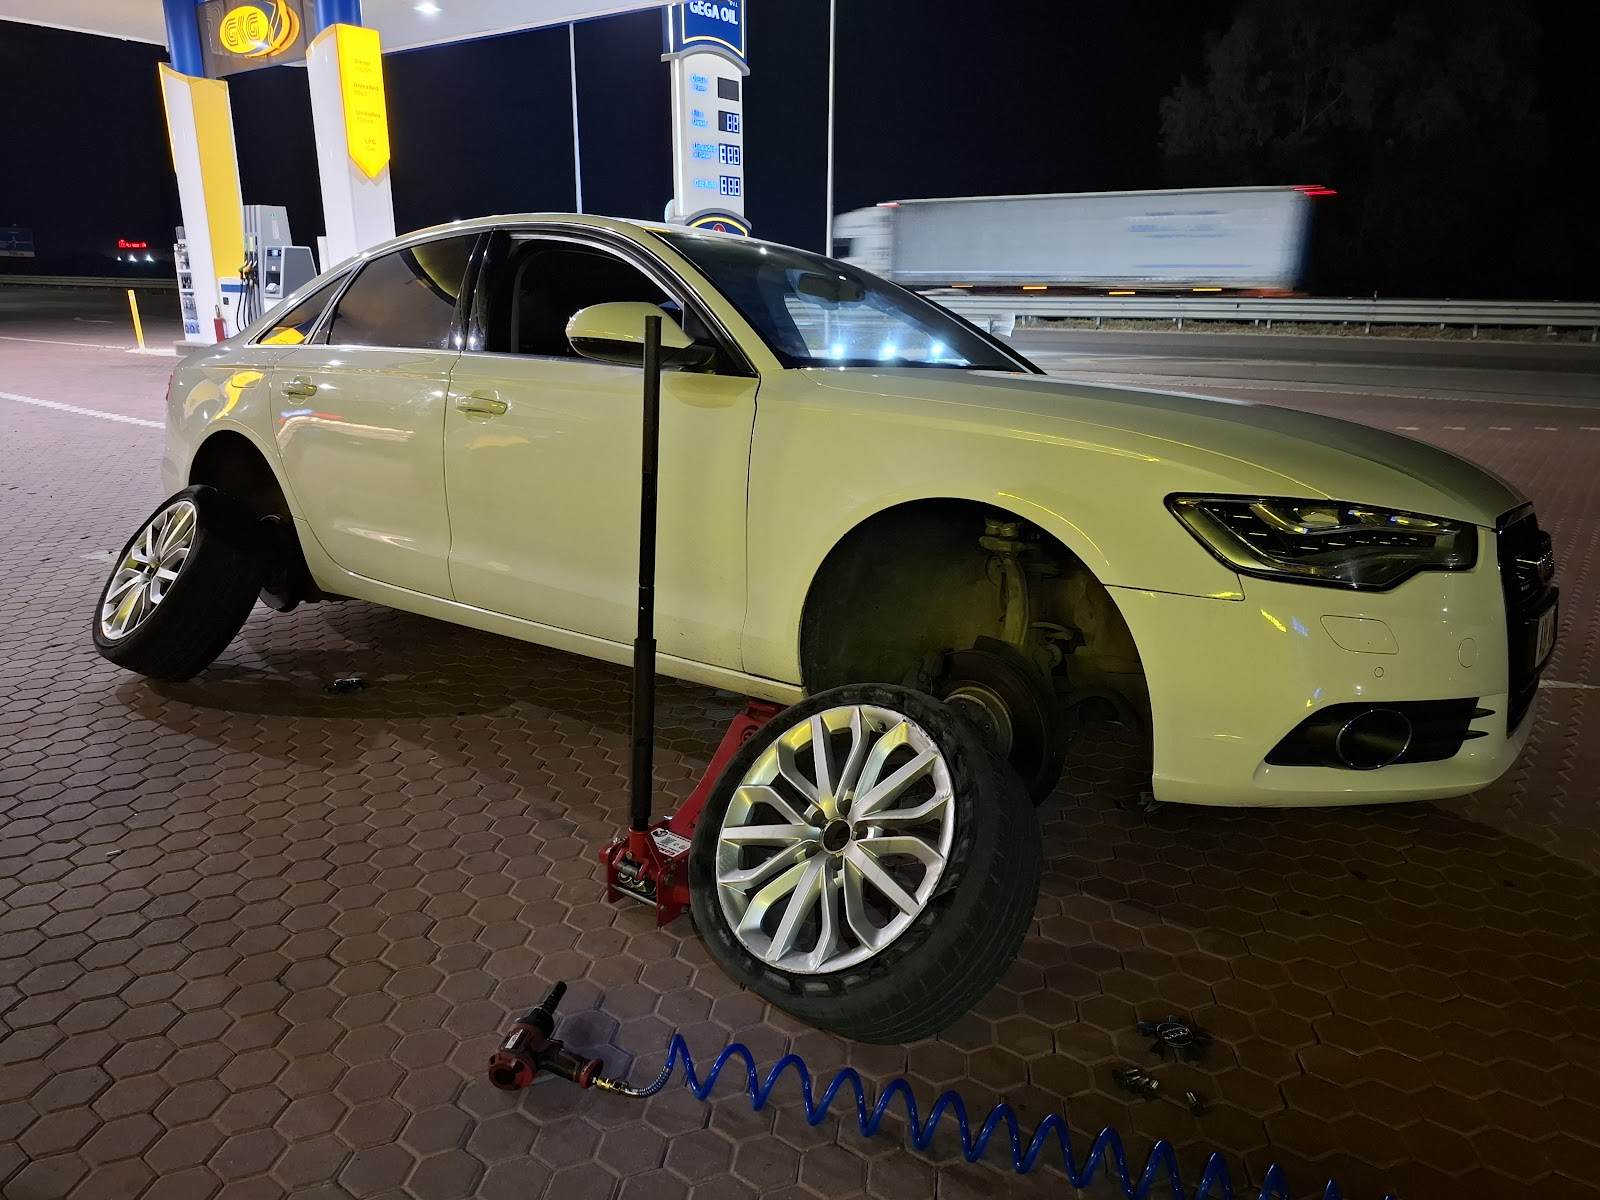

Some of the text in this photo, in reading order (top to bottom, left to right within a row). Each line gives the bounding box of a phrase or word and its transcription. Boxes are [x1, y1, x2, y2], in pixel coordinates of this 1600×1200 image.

[690, 0, 739, 25] GEGA OIL
[353, 82, 379, 91] Unleaded
[355, 109, 381, 119] Unleaded
